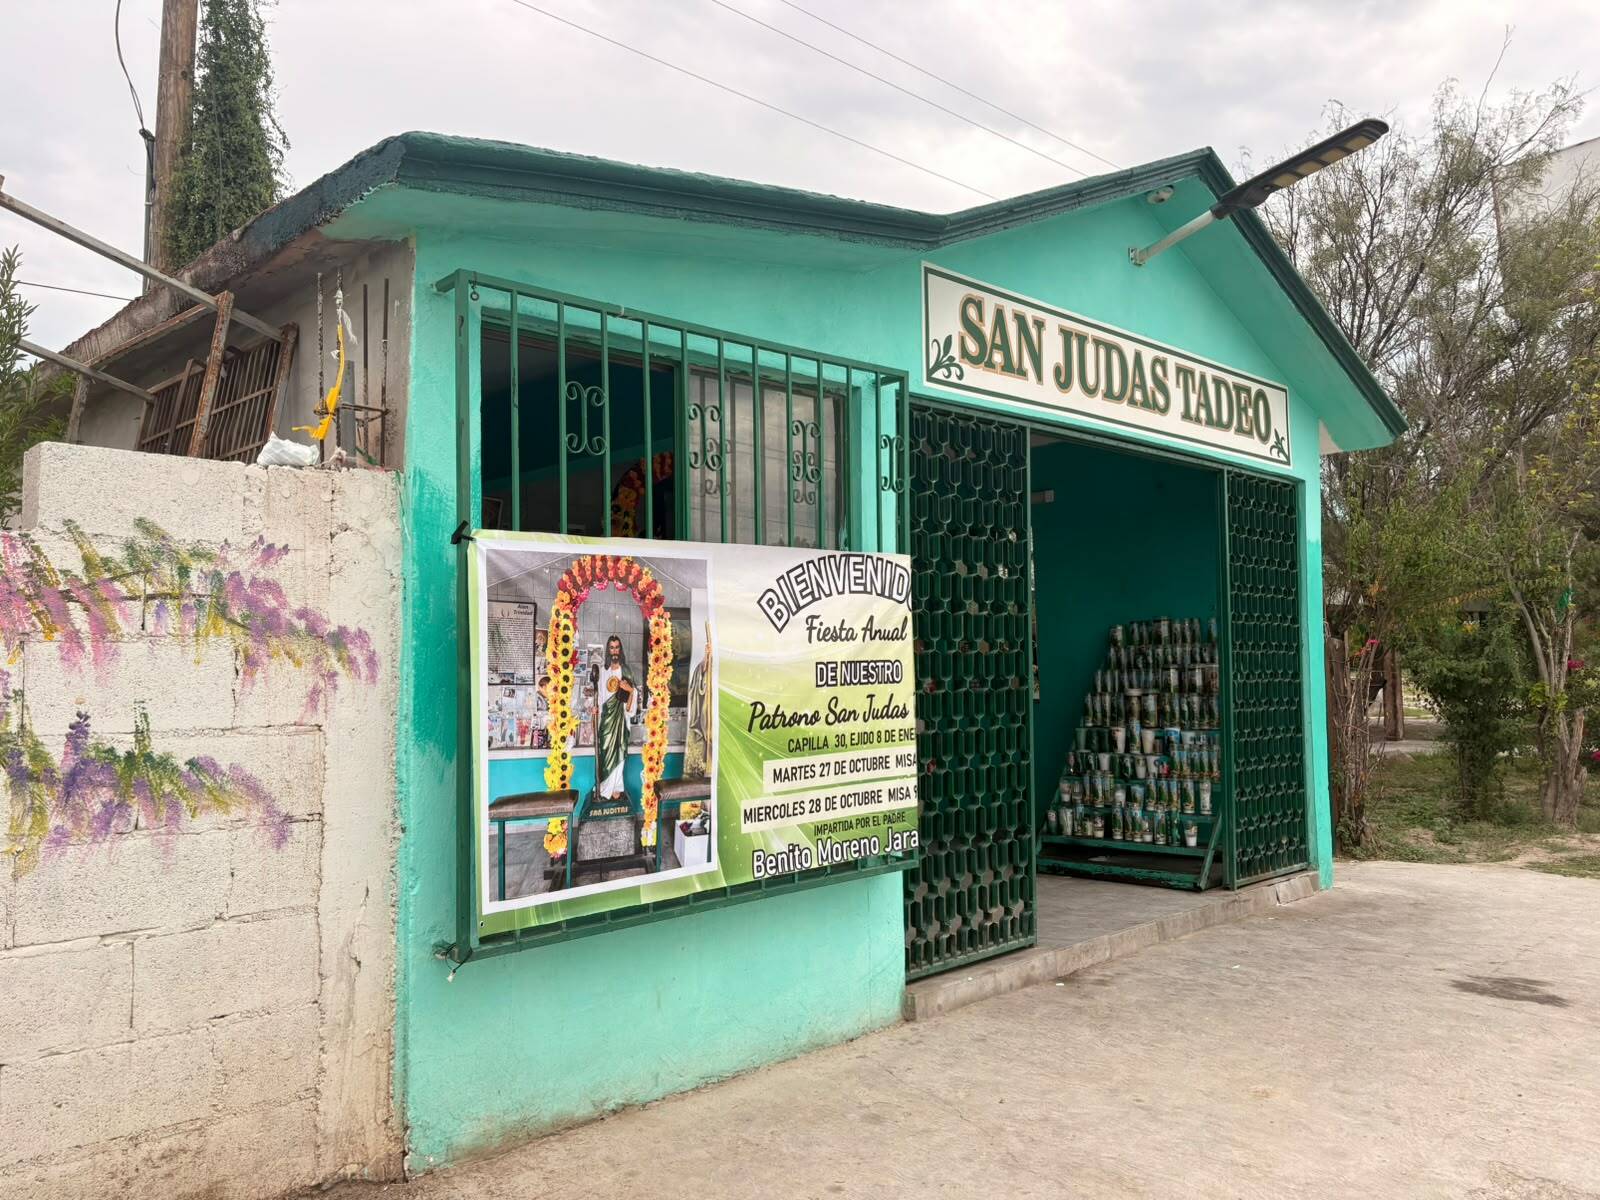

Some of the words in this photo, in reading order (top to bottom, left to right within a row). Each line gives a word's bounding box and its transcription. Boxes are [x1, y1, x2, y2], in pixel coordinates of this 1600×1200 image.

[958, 293, 1046, 385] SAN
[1053, 325, 1172, 417] JUDAS
[1175, 362, 1273, 445] TADEO
[805, 614, 857, 644] Fiesta
[862, 615, 908, 641] Anual
[815, 661, 838, 688] DE
[840, 660, 903, 686] NUESTRO
[747, 701, 821, 733] Patrono
[825, 696, 860, 726] San
[863, 692, 909, 723] Judas
[788, 736, 829, 753] CAPILLA
[850, 731, 875, 747] EJIDO
[876, 730, 882, 743] 8
[884, 729, 896, 743] DE
[898, 727, 916, 742] ENE
[773, 763, 816, 783] MARTES
[819, 761, 831, 777] 27
[834, 760, 847, 776] DE
[849, 755, 891, 774] OCTUBRE
[895, 753, 916, 769] MISA
[743, 800, 805, 824] MIERCOLES
[808, 798, 822, 815] 28
[825, 796, 838, 812] DE
[840, 789, 883, 809] OCTUBRE
[888, 785, 911, 802] MISA
[814, 819, 854, 837] IMPARTIDA
[855, 816, 871, 830] POR
[872, 814, 881, 827] EL
[883, 811, 906, 826] PADRE
[752, 842, 812, 879] Benito
[817, 834, 879, 866] Moreno
